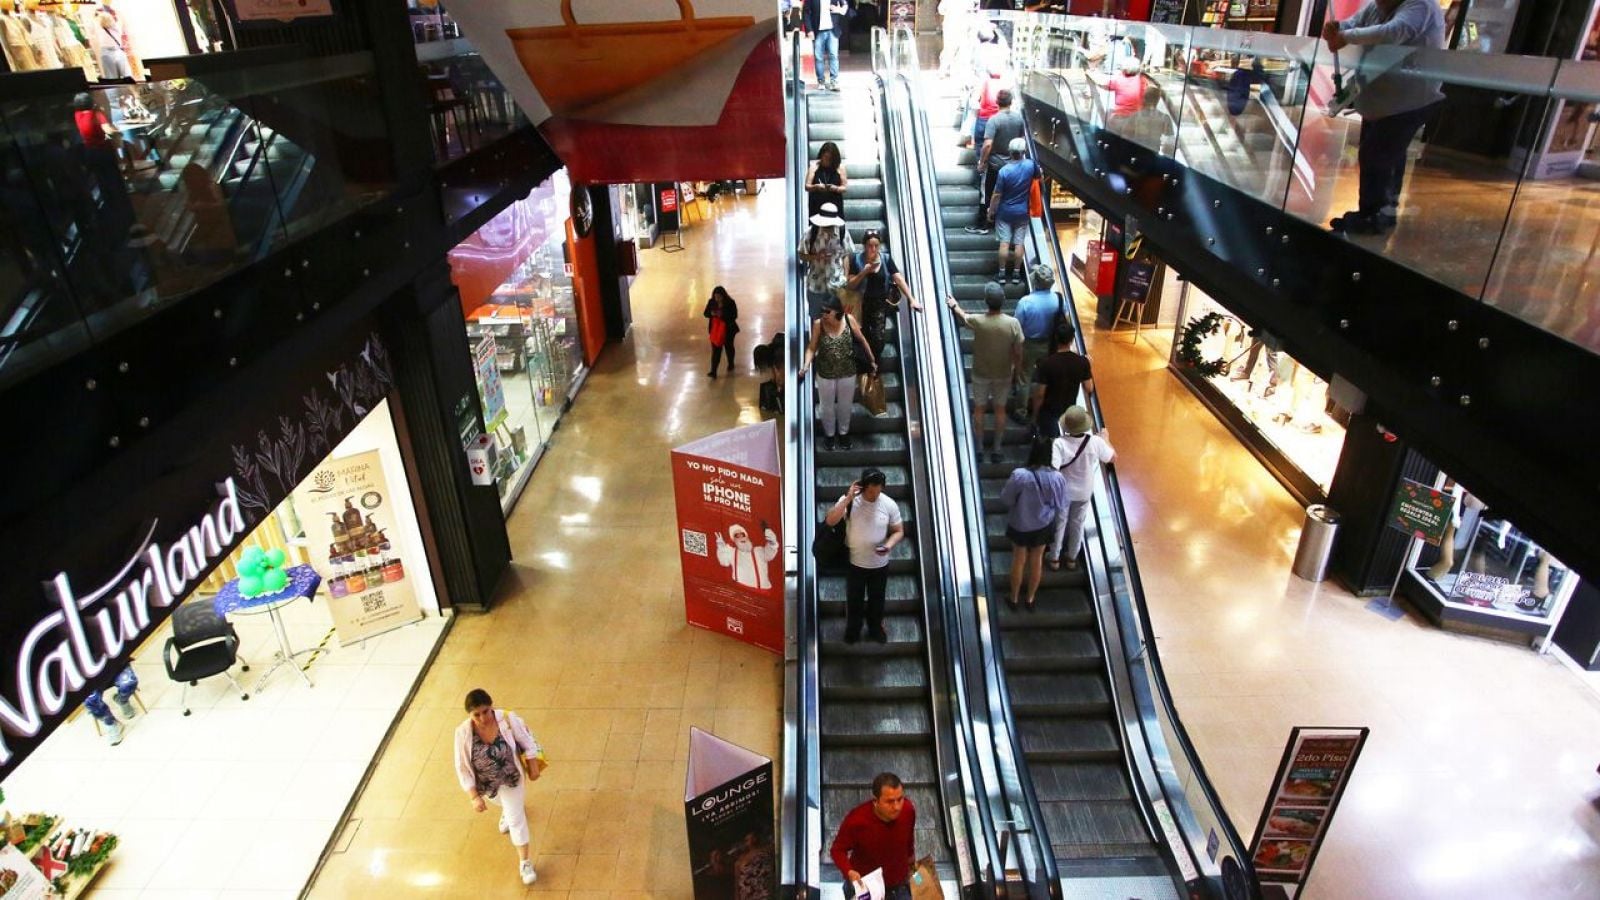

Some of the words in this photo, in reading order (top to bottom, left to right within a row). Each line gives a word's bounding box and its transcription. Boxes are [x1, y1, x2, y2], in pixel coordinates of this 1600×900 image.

[687, 460, 700, 470] YO
[702, 463, 716, 473] NO
[718, 467, 738, 479] PIDO
[739, 473, 765, 487] NADA
[703, 482, 751, 506] IPHONE
[704, 493, 712, 502] 16
[714, 495, 731, 506] PRO
[733, 501, 752, 514] MAX
[0, 477, 246, 766] Naturland
[1322, 752, 1348, 762] Piso
[692, 772, 768, 816] LOUNGE
